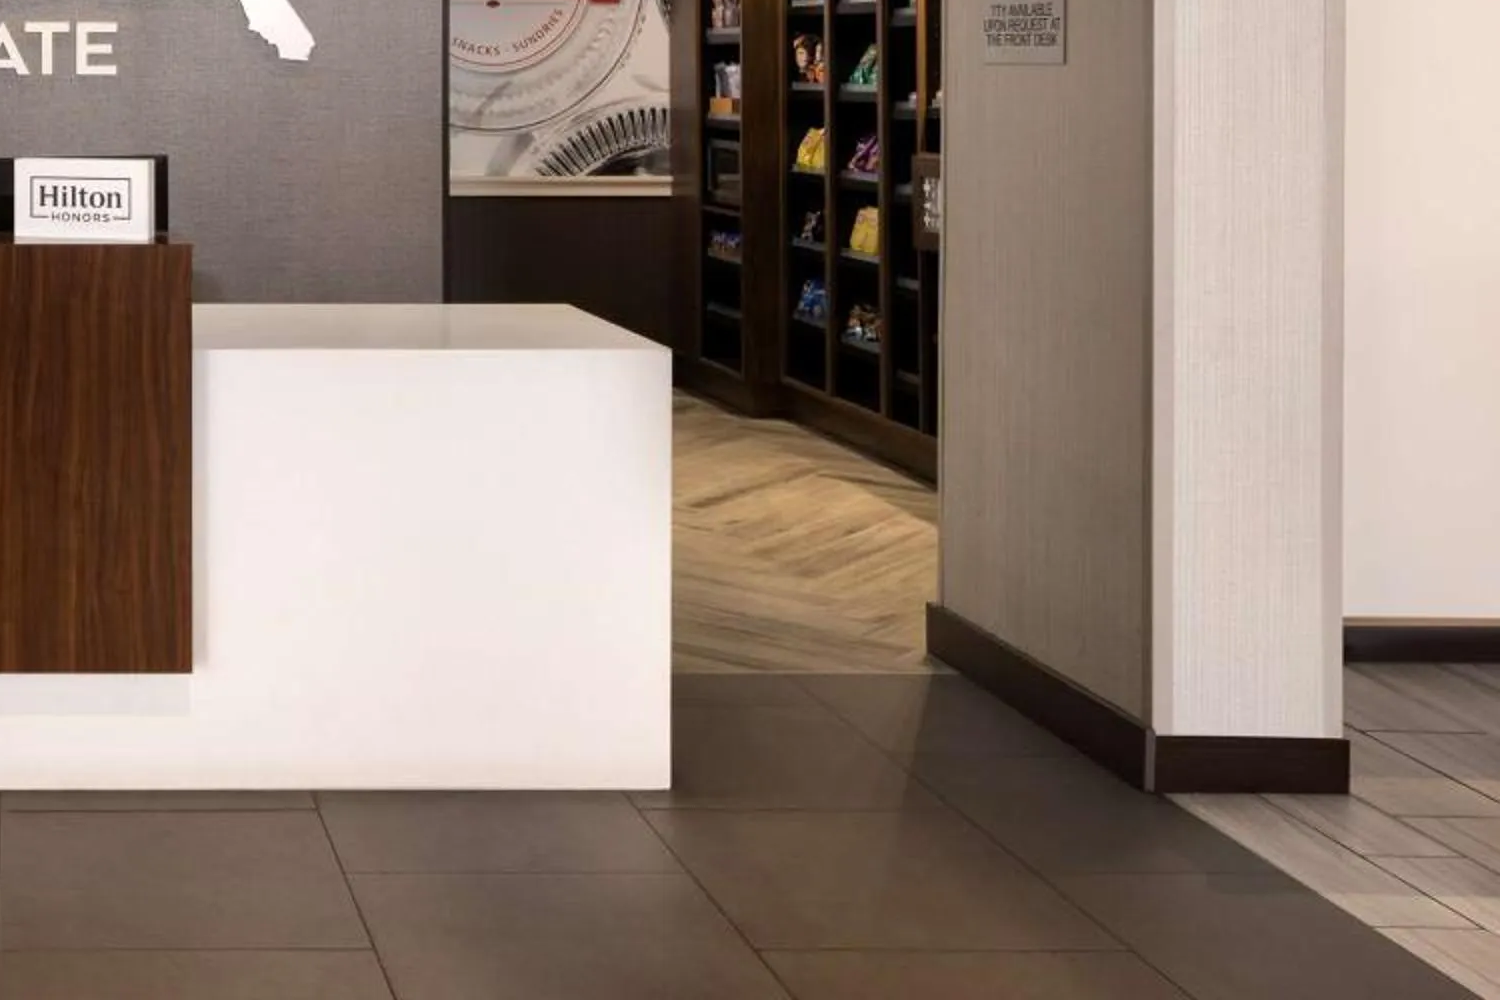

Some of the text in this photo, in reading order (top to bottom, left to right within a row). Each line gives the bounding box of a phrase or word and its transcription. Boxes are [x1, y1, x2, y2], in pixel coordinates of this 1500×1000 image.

[1008, 2, 1053, 16] AVAILABLE
[983, 19, 1006, 32] UPON
[1008, 18, 1049, 32] REQUEST
[452, 9, 564, 56] SNACKS SUNDRIES
[986, 33, 1058, 46] THE FRONT DESK
[39, 184, 123, 209] Hilton
[51, 212, 111, 223] HONORS
